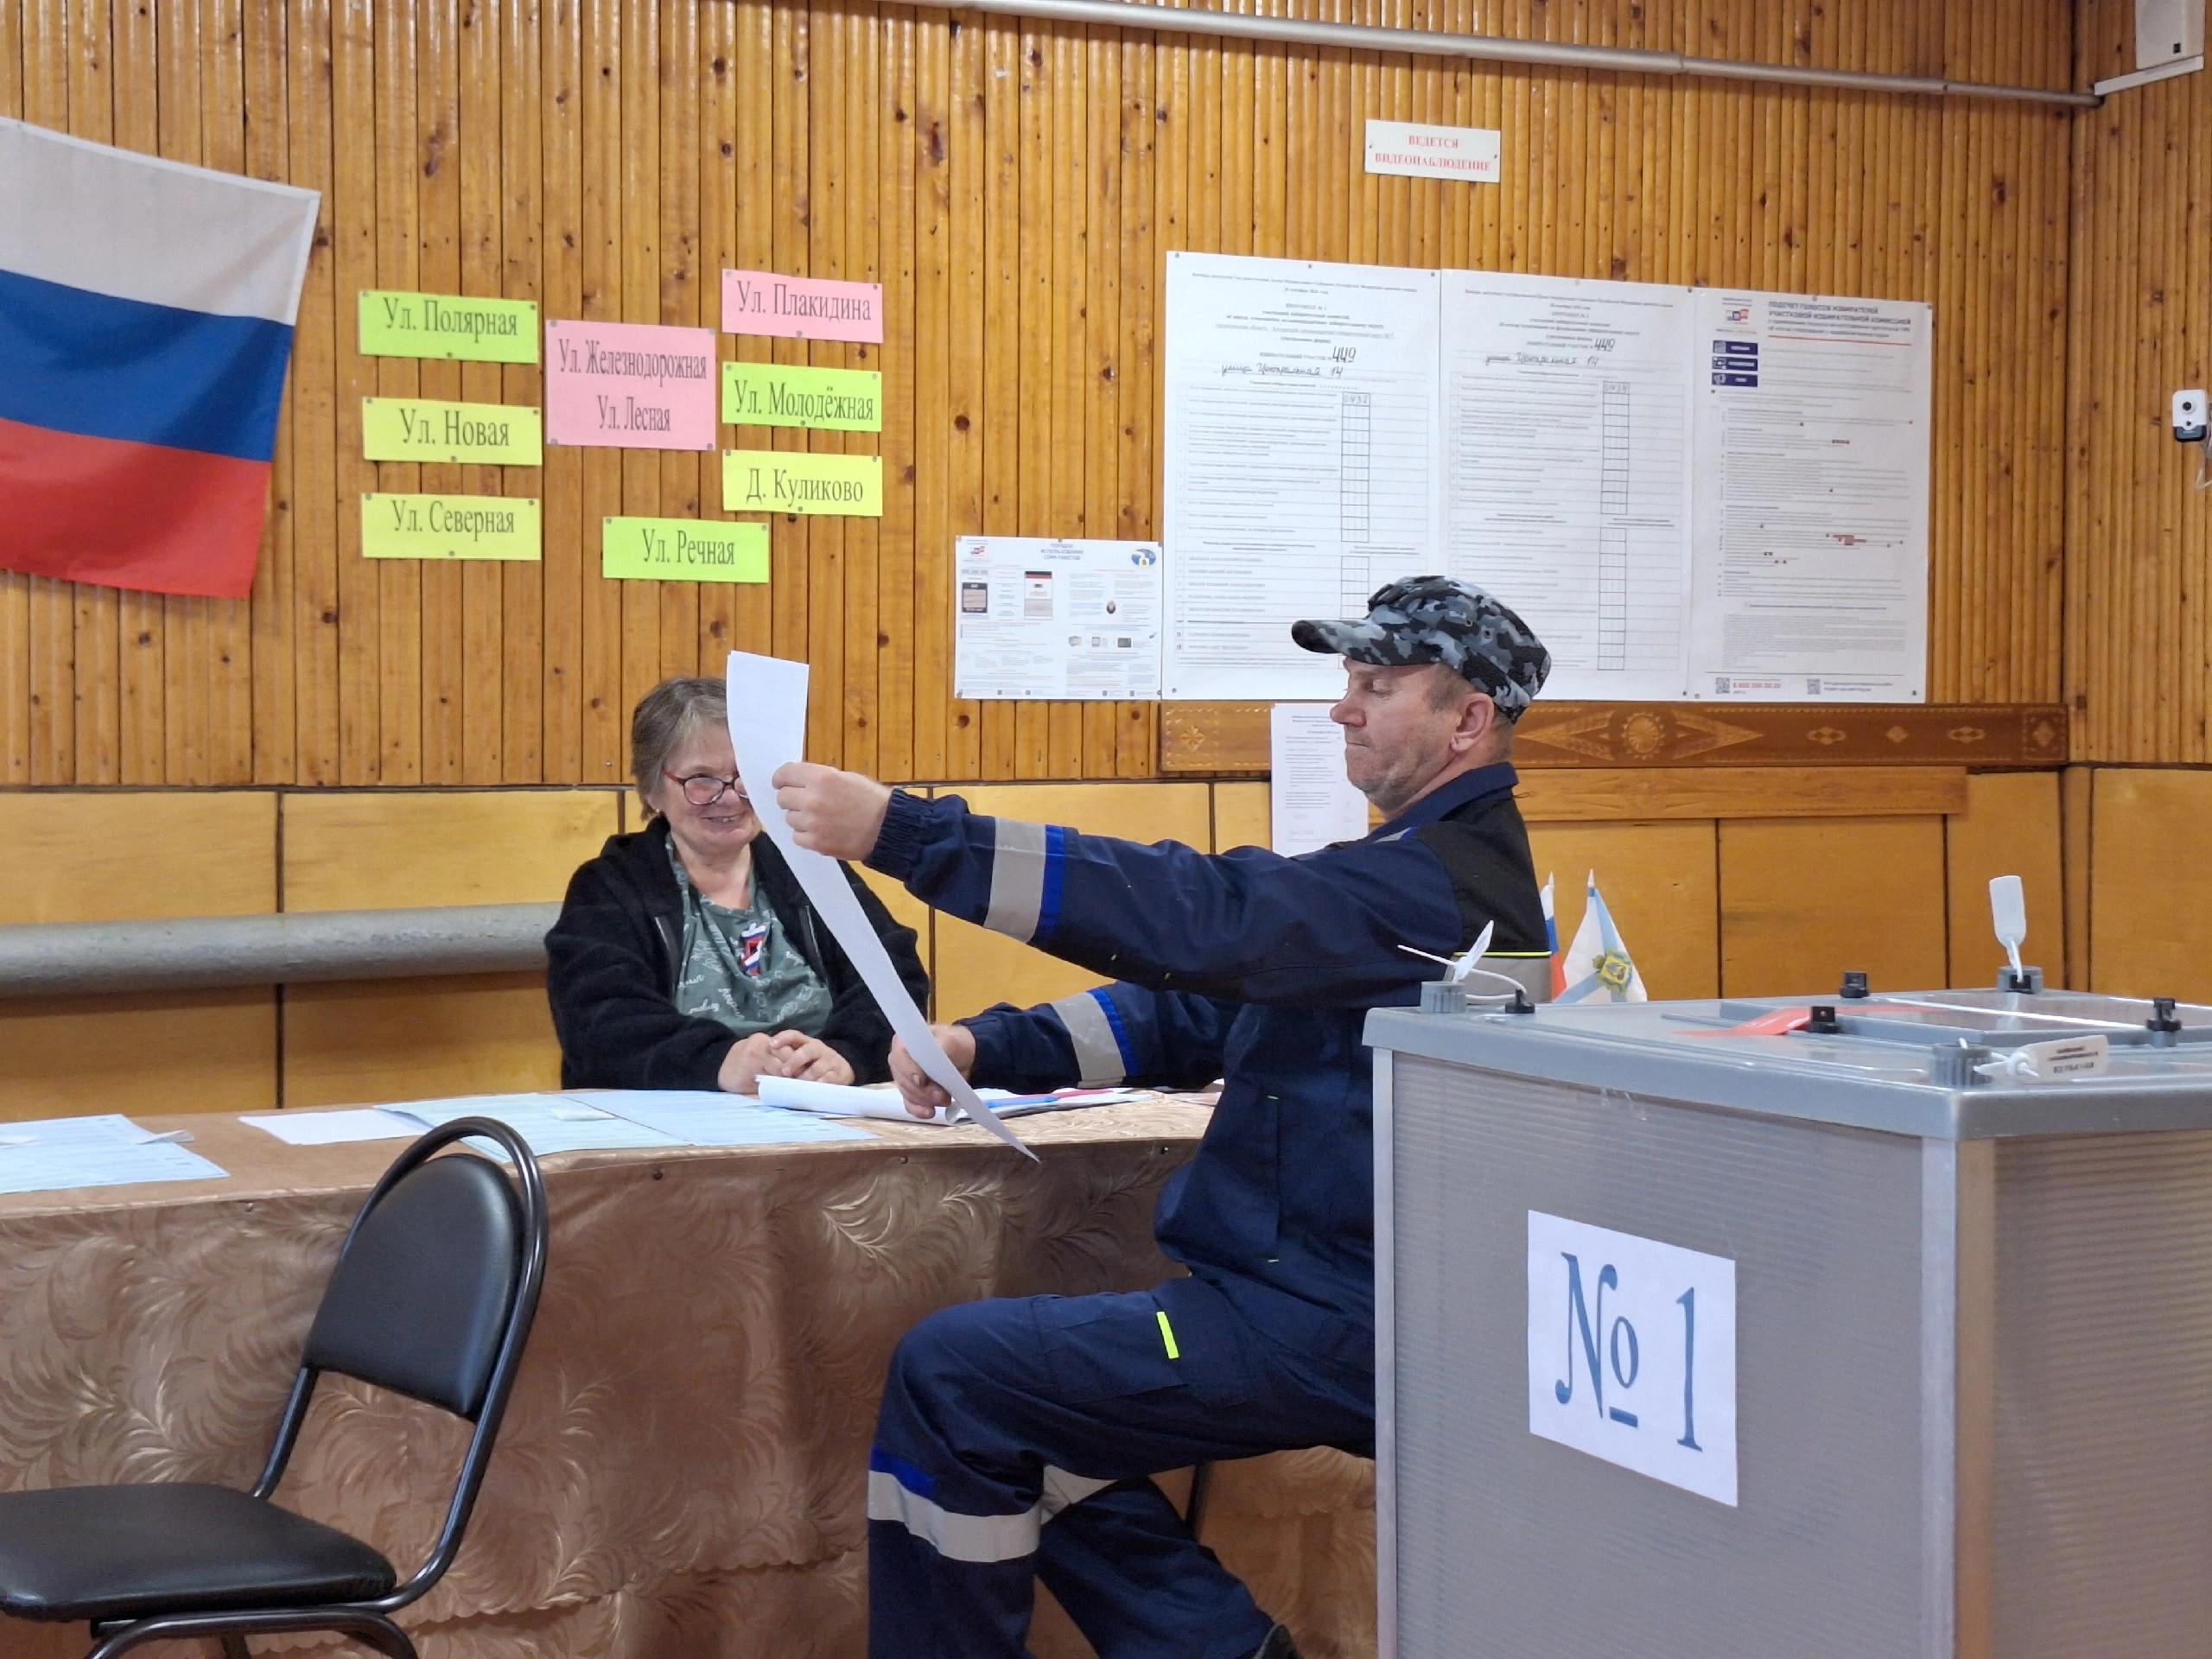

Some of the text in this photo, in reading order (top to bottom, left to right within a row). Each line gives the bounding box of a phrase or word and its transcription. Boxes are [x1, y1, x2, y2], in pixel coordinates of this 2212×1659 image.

[1375, 152, 1491, 172] ВИДЕОНАБЛЮДЕНИЕ
[1408, 135, 1459, 149] ВЕДЕТСЯ
[383, 296, 518, 344] Ул. Полярная
[737, 280, 872, 323] Ул. Плакидина
[558, 338, 708, 388] Ул. Железнодорожная
[597, 395, 671, 432] Ул. Лесная
[734, 379, 874, 423] Ул. Молодёжная
[398, 408, 510, 447] Ул. Новая
[746, 467, 864, 507] Д. Куликово
[391, 499, 514, 543] Ул. Северная
[642, 528, 735, 565] Ул. Речная
[1554, 1250, 1704, 1453] № 1
